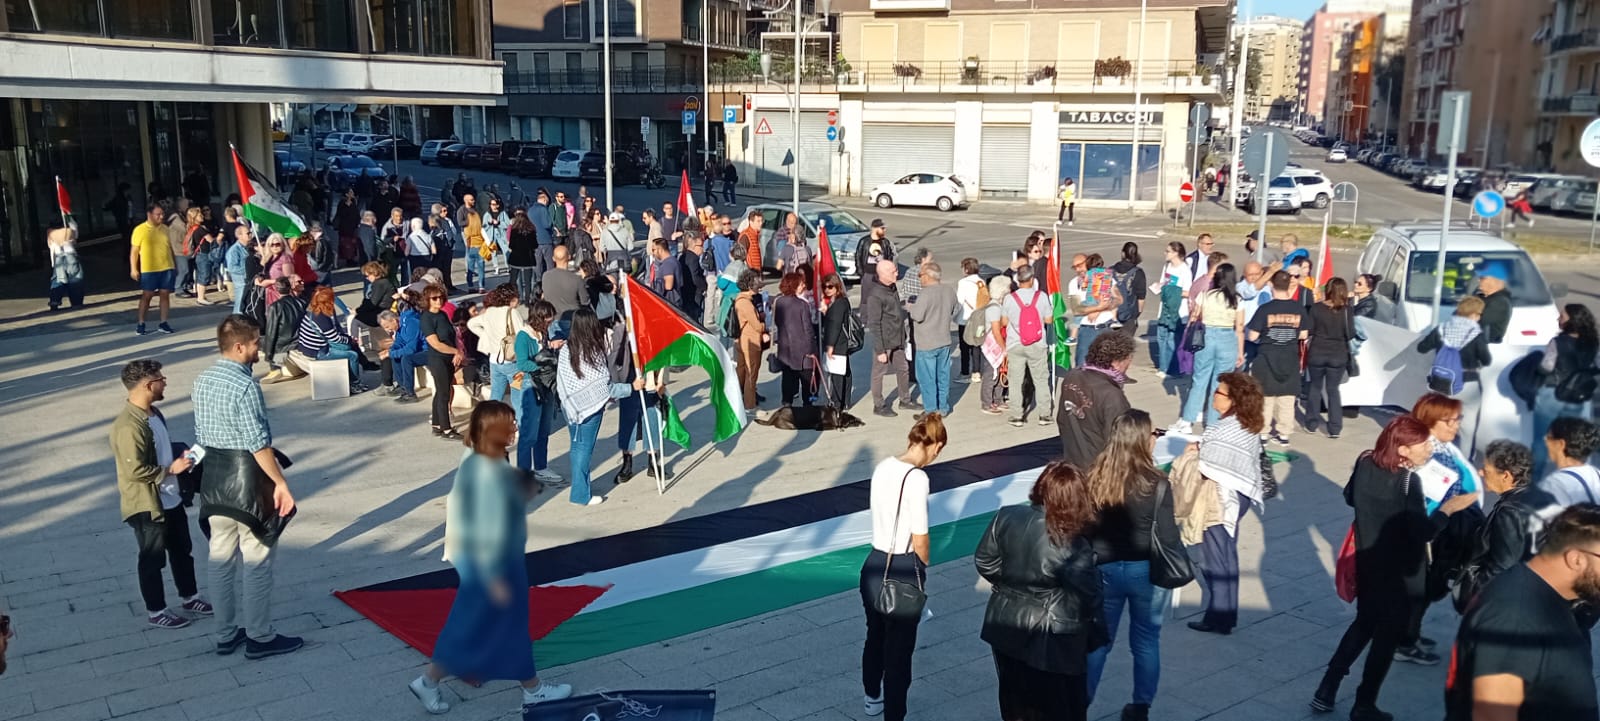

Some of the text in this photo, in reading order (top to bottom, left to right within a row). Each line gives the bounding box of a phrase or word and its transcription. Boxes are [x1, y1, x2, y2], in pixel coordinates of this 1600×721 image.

[684, 112, 693, 124] P
[725, 110, 734, 122] P
[1068, 111, 1154, 123] TABACCHI
